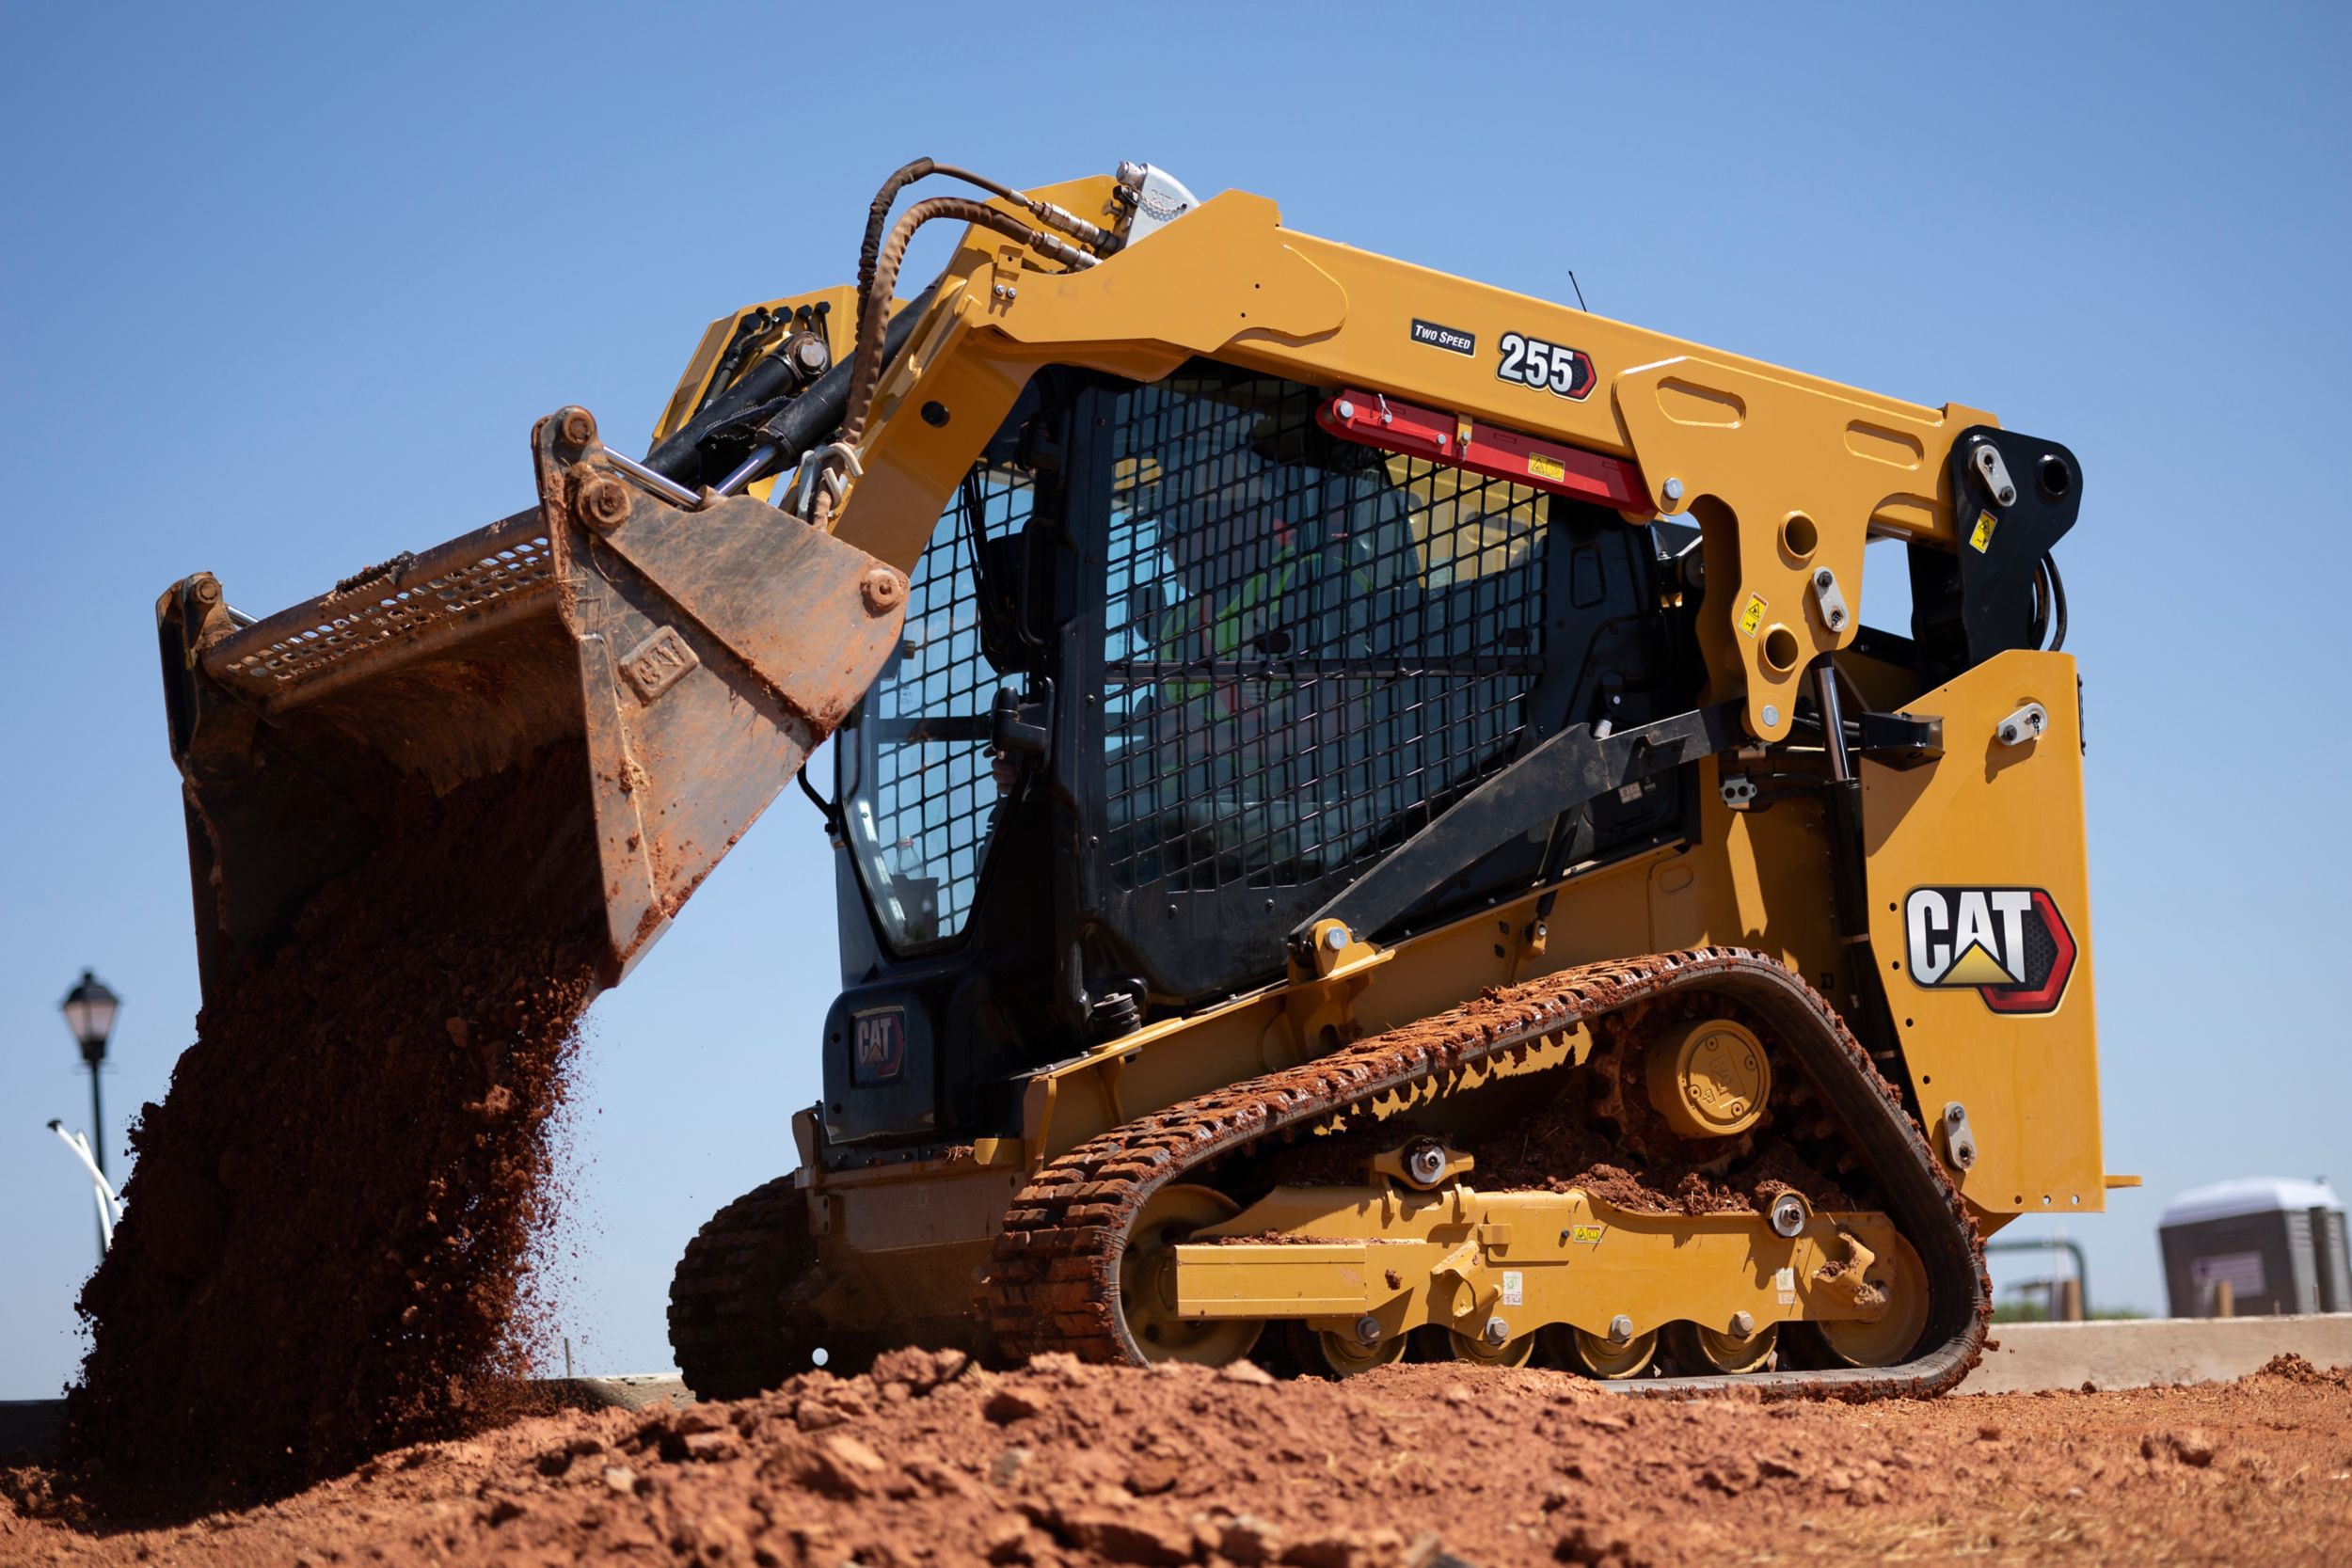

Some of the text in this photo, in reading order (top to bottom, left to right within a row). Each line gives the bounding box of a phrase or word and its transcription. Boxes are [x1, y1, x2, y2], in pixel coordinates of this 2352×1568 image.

[1415, 325, 1471, 350] TWO SPEED
[1500, 334, 1574, 393] 255
[634, 635, 685, 690] CAT
[1907, 889, 2032, 985] CAT
[857, 1017, 892, 1065] CAT
